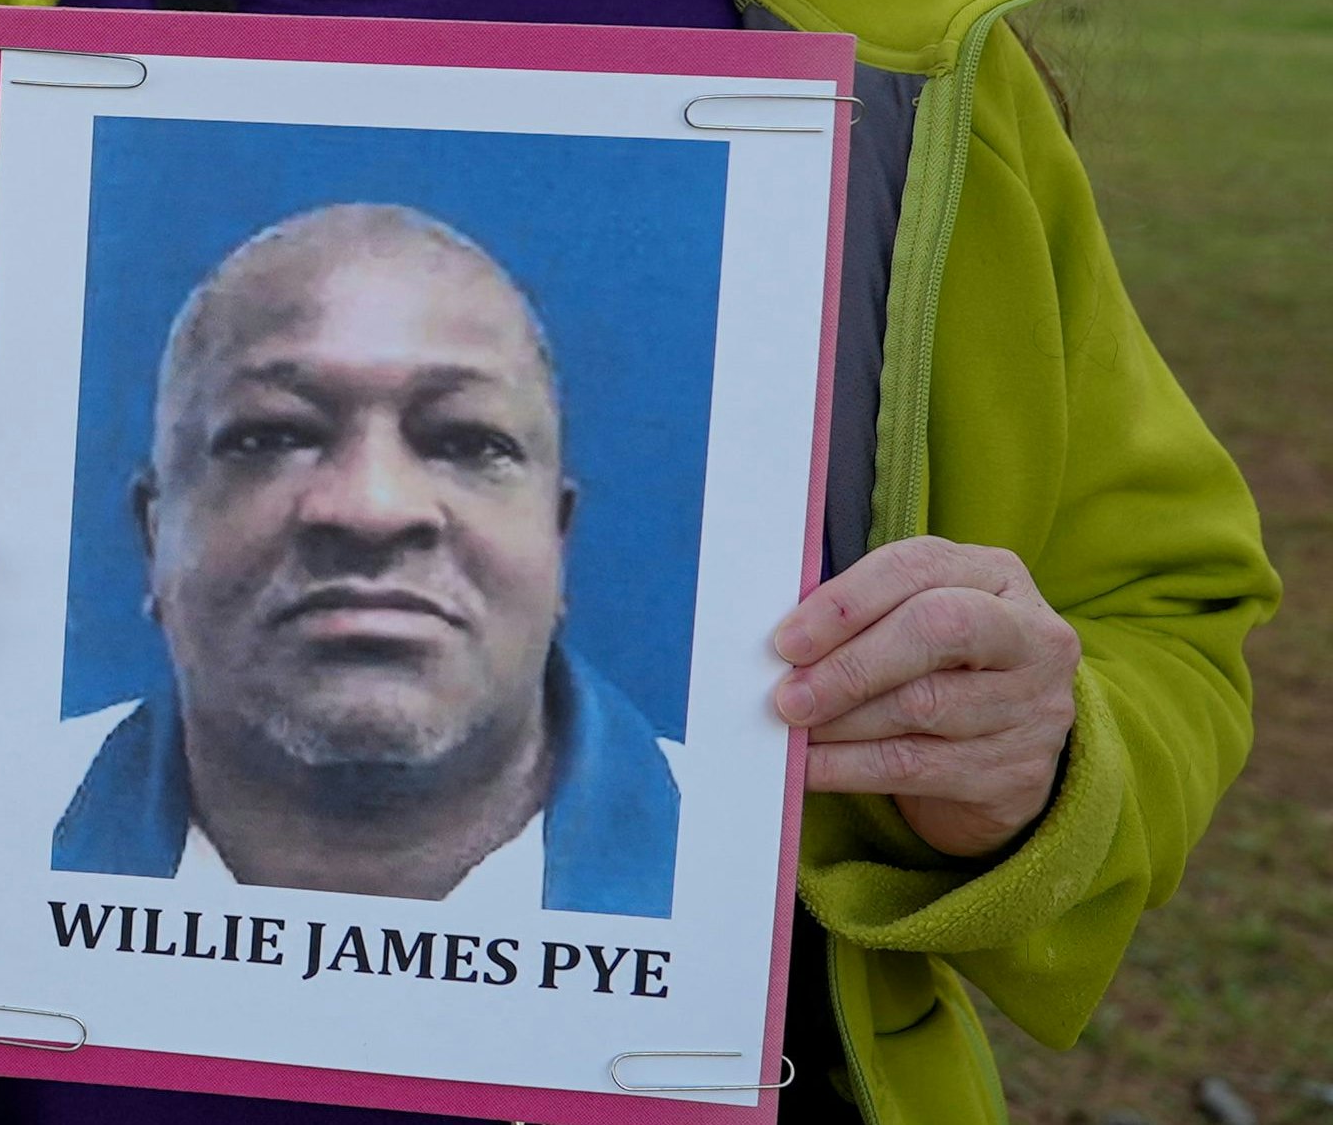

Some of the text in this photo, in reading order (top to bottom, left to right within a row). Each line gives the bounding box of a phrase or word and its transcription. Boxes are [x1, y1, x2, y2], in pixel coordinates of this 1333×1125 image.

[48, 901, 672, 999] WILLIE JAMES PYE
